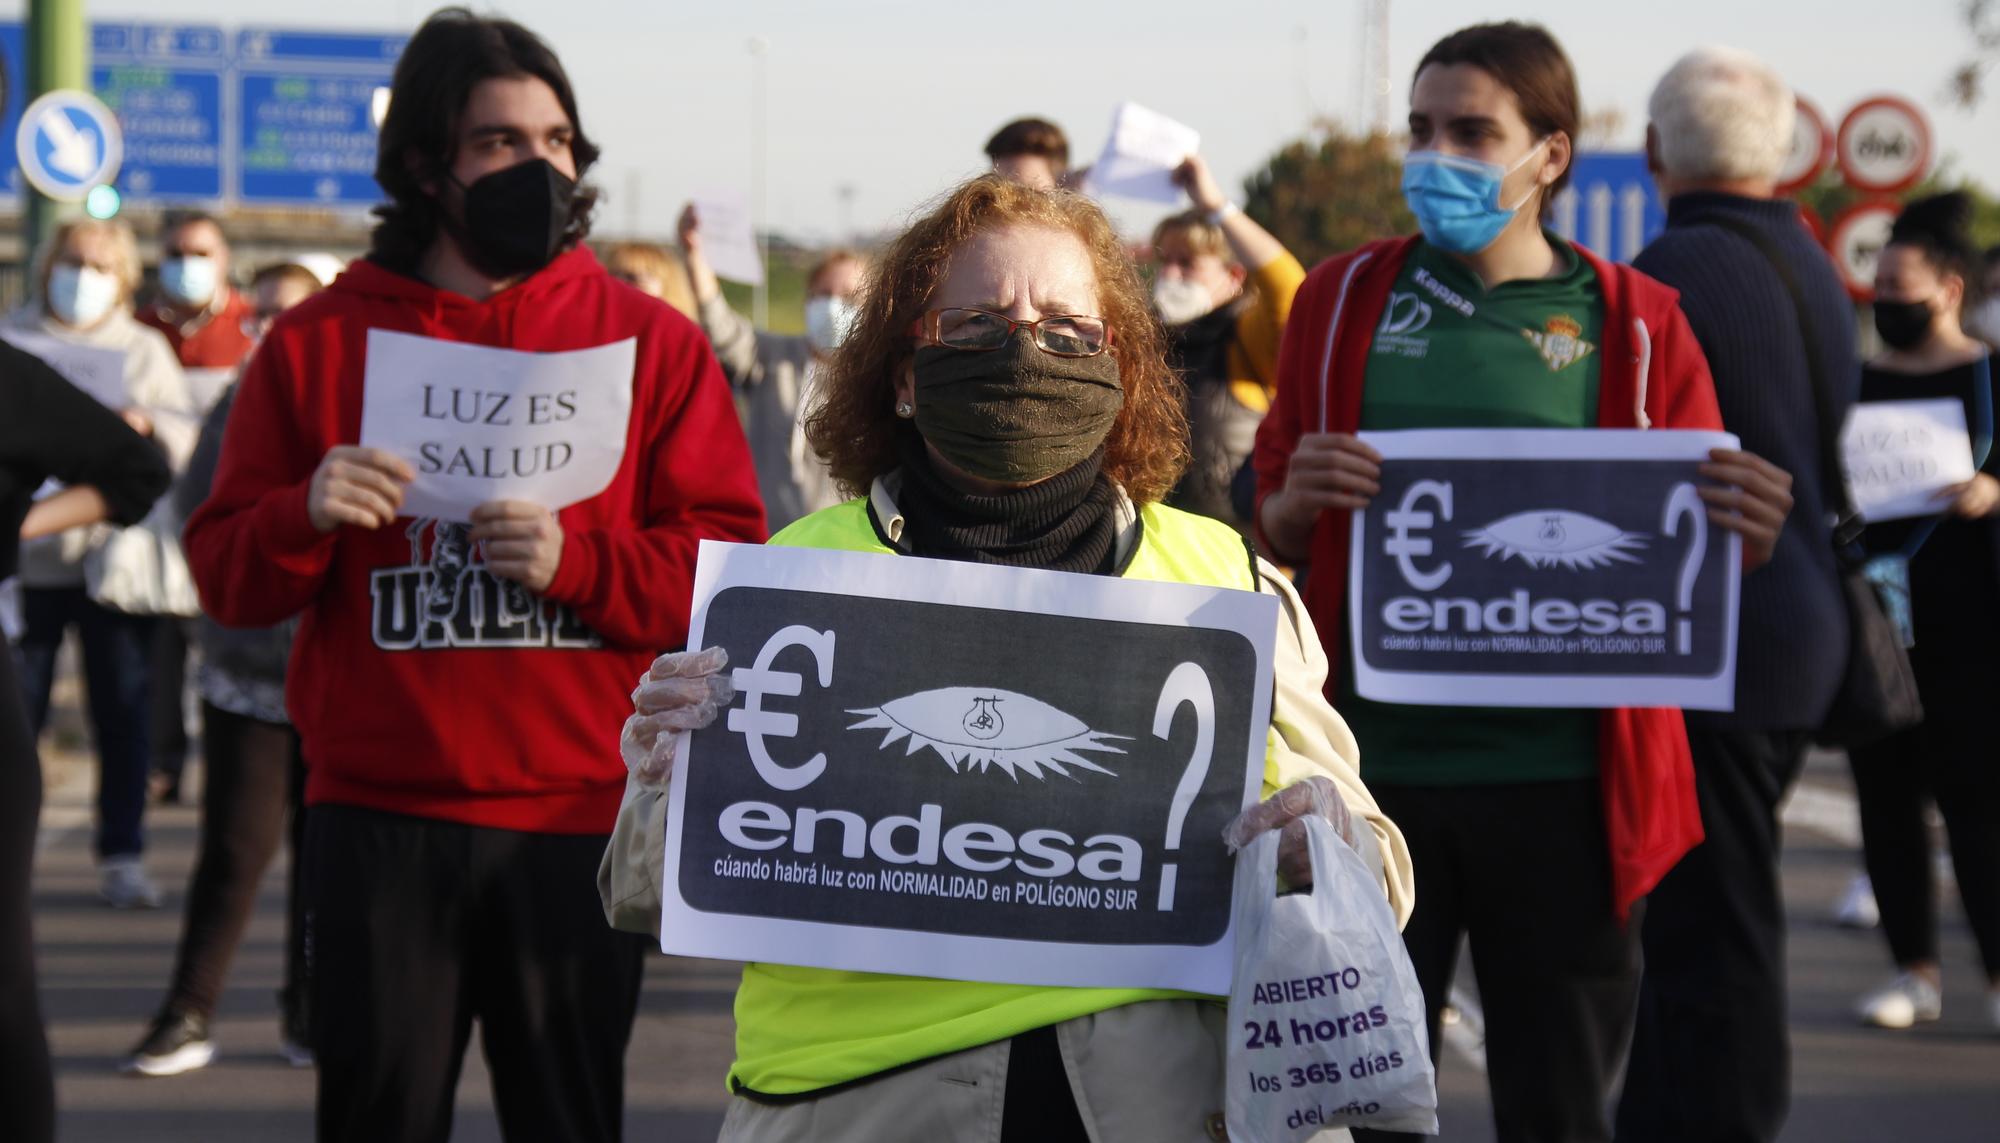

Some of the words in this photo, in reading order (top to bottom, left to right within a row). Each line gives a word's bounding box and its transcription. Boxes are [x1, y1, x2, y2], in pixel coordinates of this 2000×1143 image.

[422, 384, 512, 426] LUZ
[528, 390, 577, 425] ES
[418, 440, 574, 479] SALUD
[1381, 589, 1666, 633] endesa
[1423, 635, 1451, 651] habrá
[1454, 636, 1469, 651] luz
[1471, 640, 1490, 651] con
[1492, 637, 1565, 653] NORMALIDAD
[1567, 641, 1580, 653] en
[1583, 635, 1641, 653] POLÍGONO
[1643, 639, 1666, 653] SUR
[718, 801, 1143, 882] endesa
[714, 853, 771, 881] cúando
[774, 858, 817, 885] habrá
[821, 864, 844, 888] luz
[847, 872, 876, 890] con
[880, 869, 988, 900] NORMALIDAD
[992, 885, 1011, 902] en
[1015, 880, 1100, 909] POLÍGONO
[1104, 888, 1138, 910] SUR
[1252, 967, 1361, 1006] ABIERTO
[1244, 1020, 1284, 1050] 24
[1290, 1004, 1389, 1046] horas
[1250, 1072, 1283, 1094] los
[1287, 1062, 1342, 1089] 365
[1350, 1050, 1404, 1080] días
[1286, 1104, 1325, 1130] del
